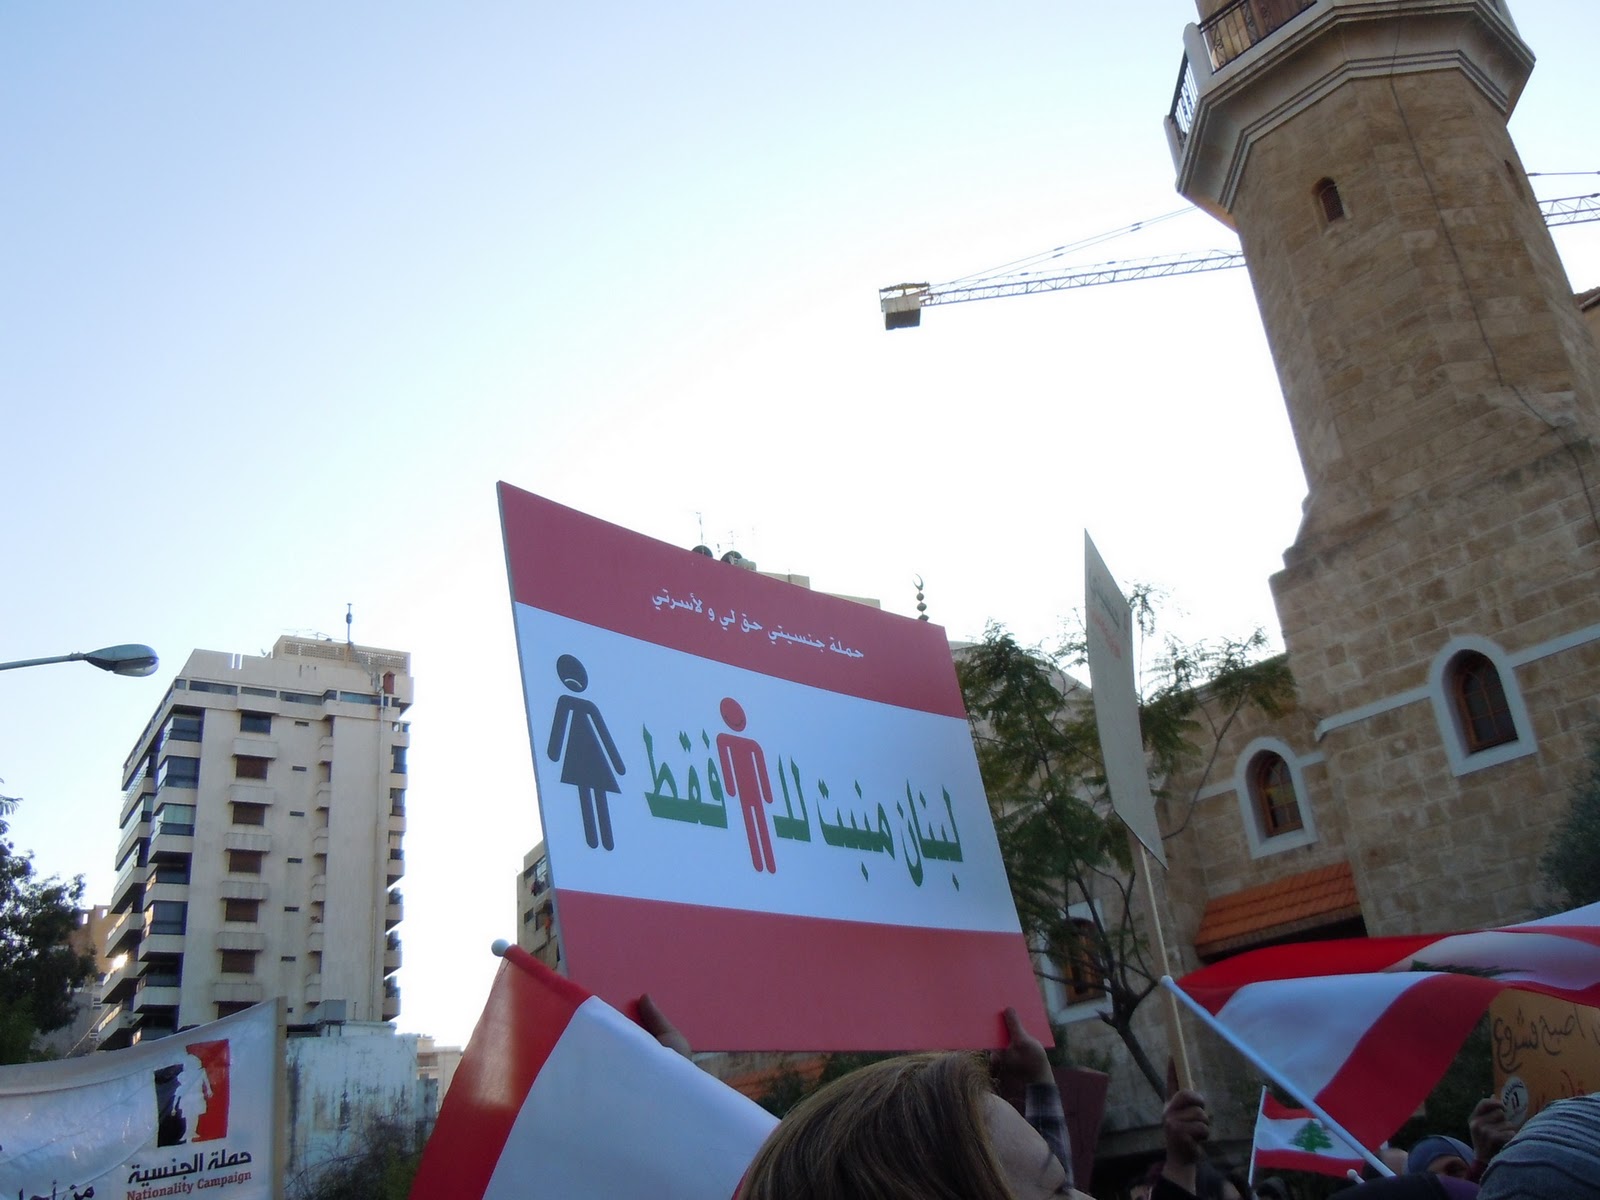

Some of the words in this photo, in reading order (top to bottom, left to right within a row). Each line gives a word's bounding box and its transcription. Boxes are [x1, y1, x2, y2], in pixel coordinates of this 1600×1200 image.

[651, 587, 703, 614] لأسرتي
[707, 607, 716, 622] و
[719, 609, 736, 631] لي
[740, 612, 763, 633] حق
[767, 624, 826, 653] جنسيتي
[829, 636, 865, 659] حملة
[642, 721, 729, 830] فقط
[897, 777, 964, 892] لبنان
[127, 1152, 204, 1187] الجنسية
[207, 1149, 252, 1171] حملة
[126, 1181, 194, 1200] Nationality
[196, 1171, 252, 1190] Campaign
